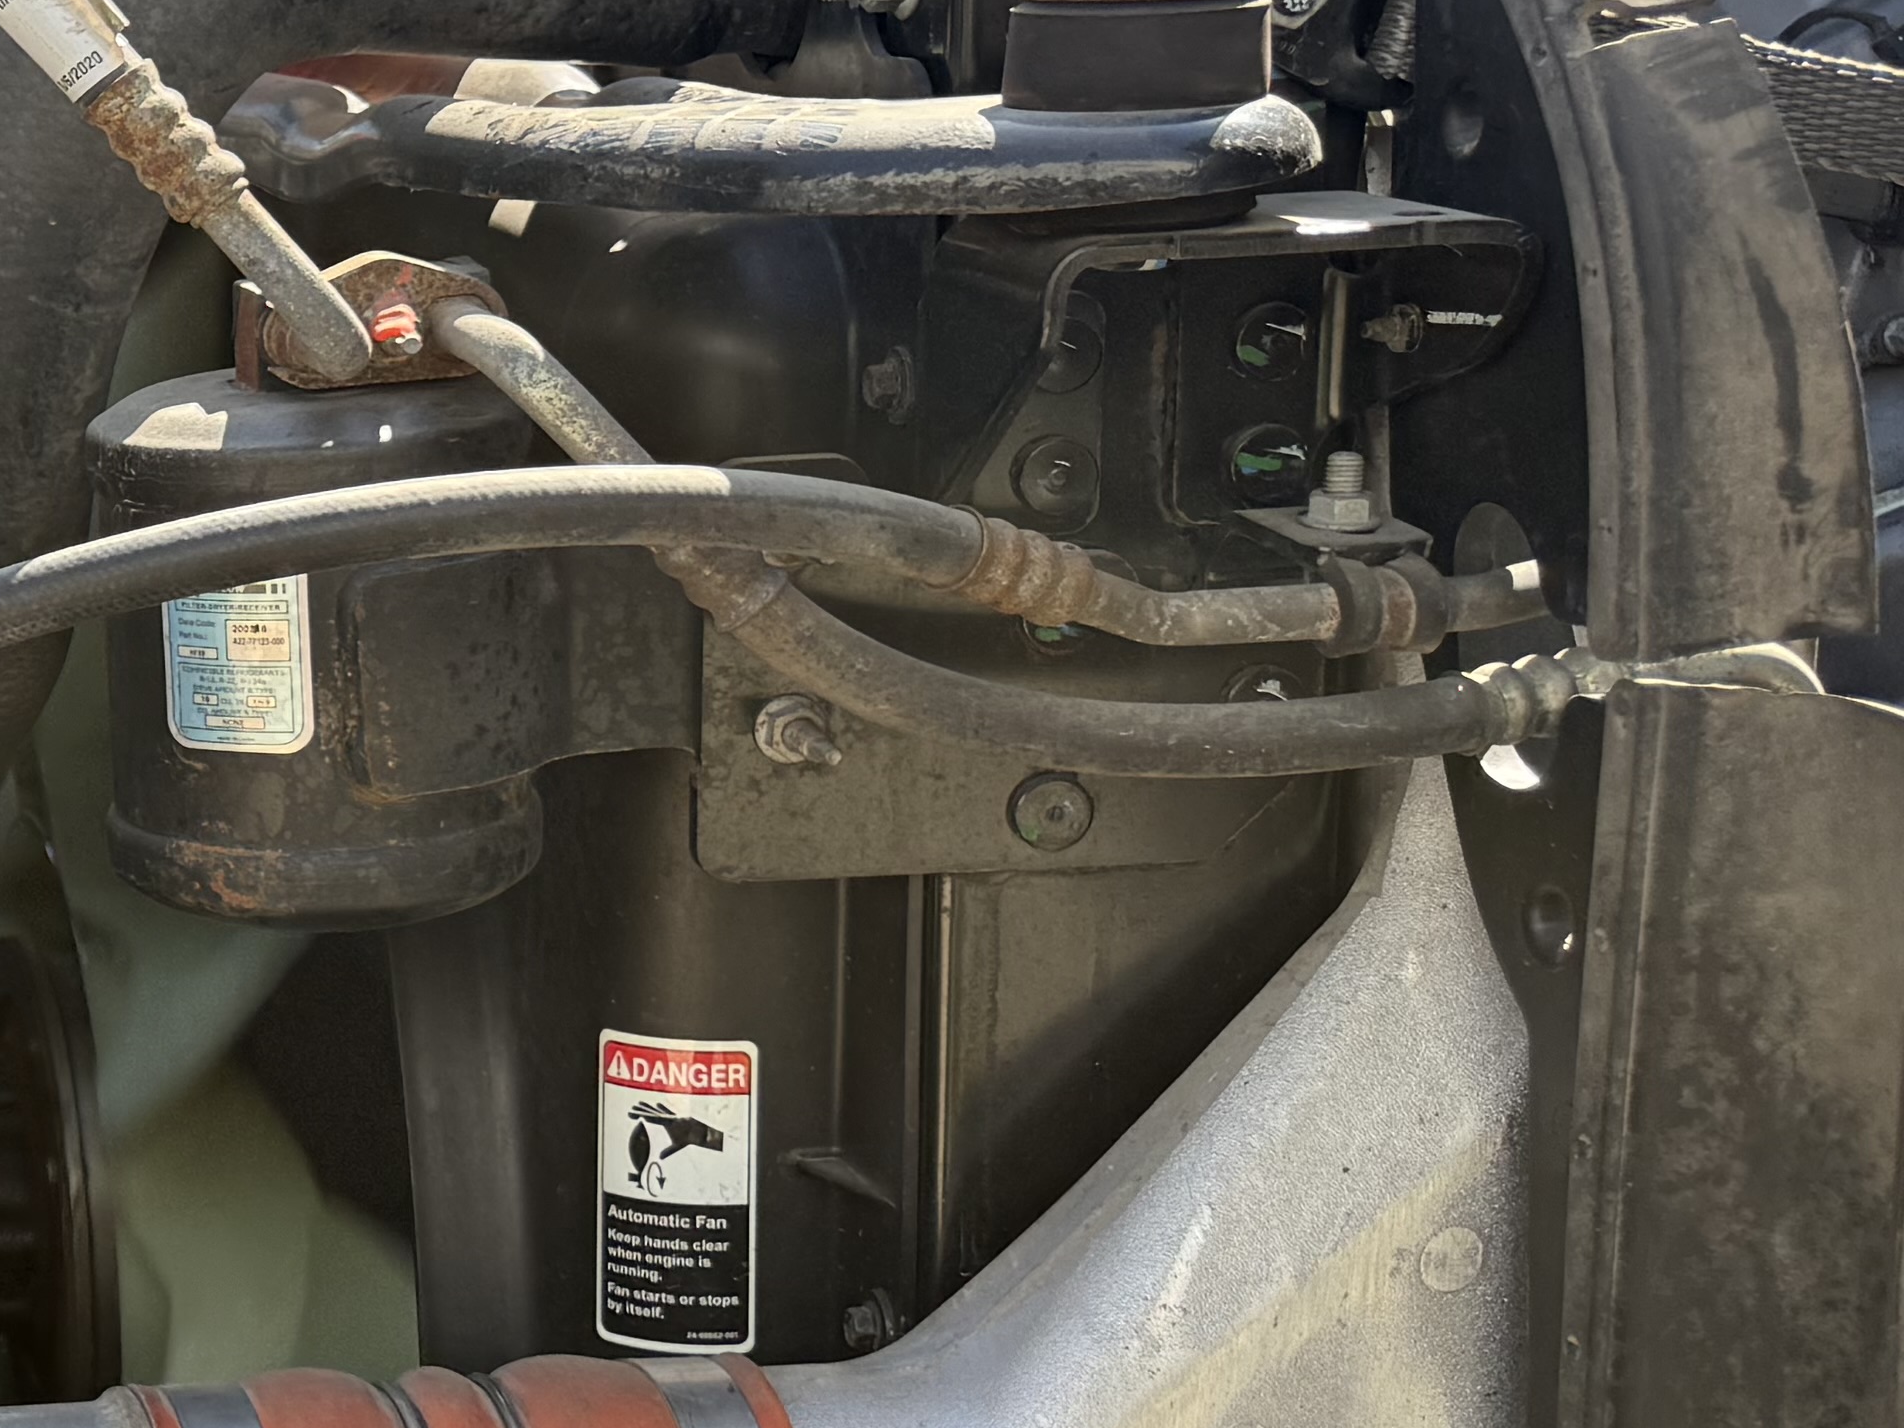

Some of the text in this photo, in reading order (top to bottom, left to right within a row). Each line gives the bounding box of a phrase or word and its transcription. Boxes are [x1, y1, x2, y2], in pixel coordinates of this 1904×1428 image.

[632, 1061, 747, 1089] DANGER
[607, 1202, 728, 1231] Automatic Fan
[607, 1227, 730, 1253] Keep hands clear
[607, 1246, 712, 1270] when engine is
[607, 1262, 663, 1282] running.
[607, 1281, 740, 1308] Fan starts or stops
[607, 1298, 665, 1320] by itself.
